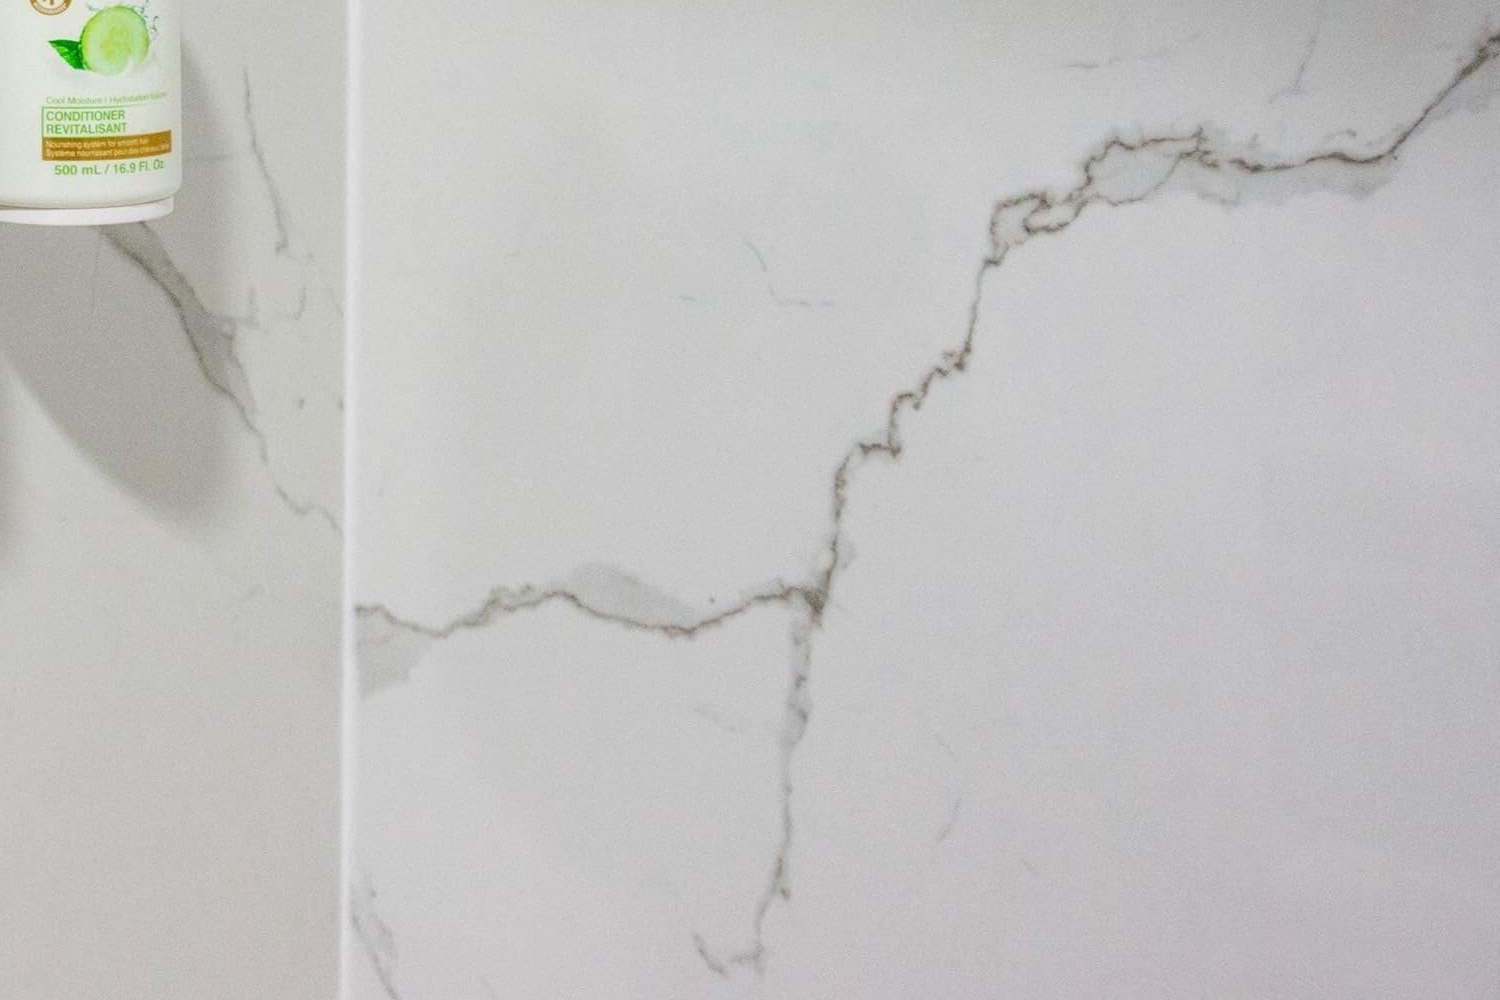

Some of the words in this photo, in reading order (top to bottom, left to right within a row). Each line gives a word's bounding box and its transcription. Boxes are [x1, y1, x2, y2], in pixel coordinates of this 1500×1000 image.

[46, 110, 125, 122] CONDITIONER
[46, 122, 127, 134] REVITALISANT
[54, 165, 77, 175] 500
[82, 165, 101, 175] mL
[113, 162, 136, 174] 16.9
